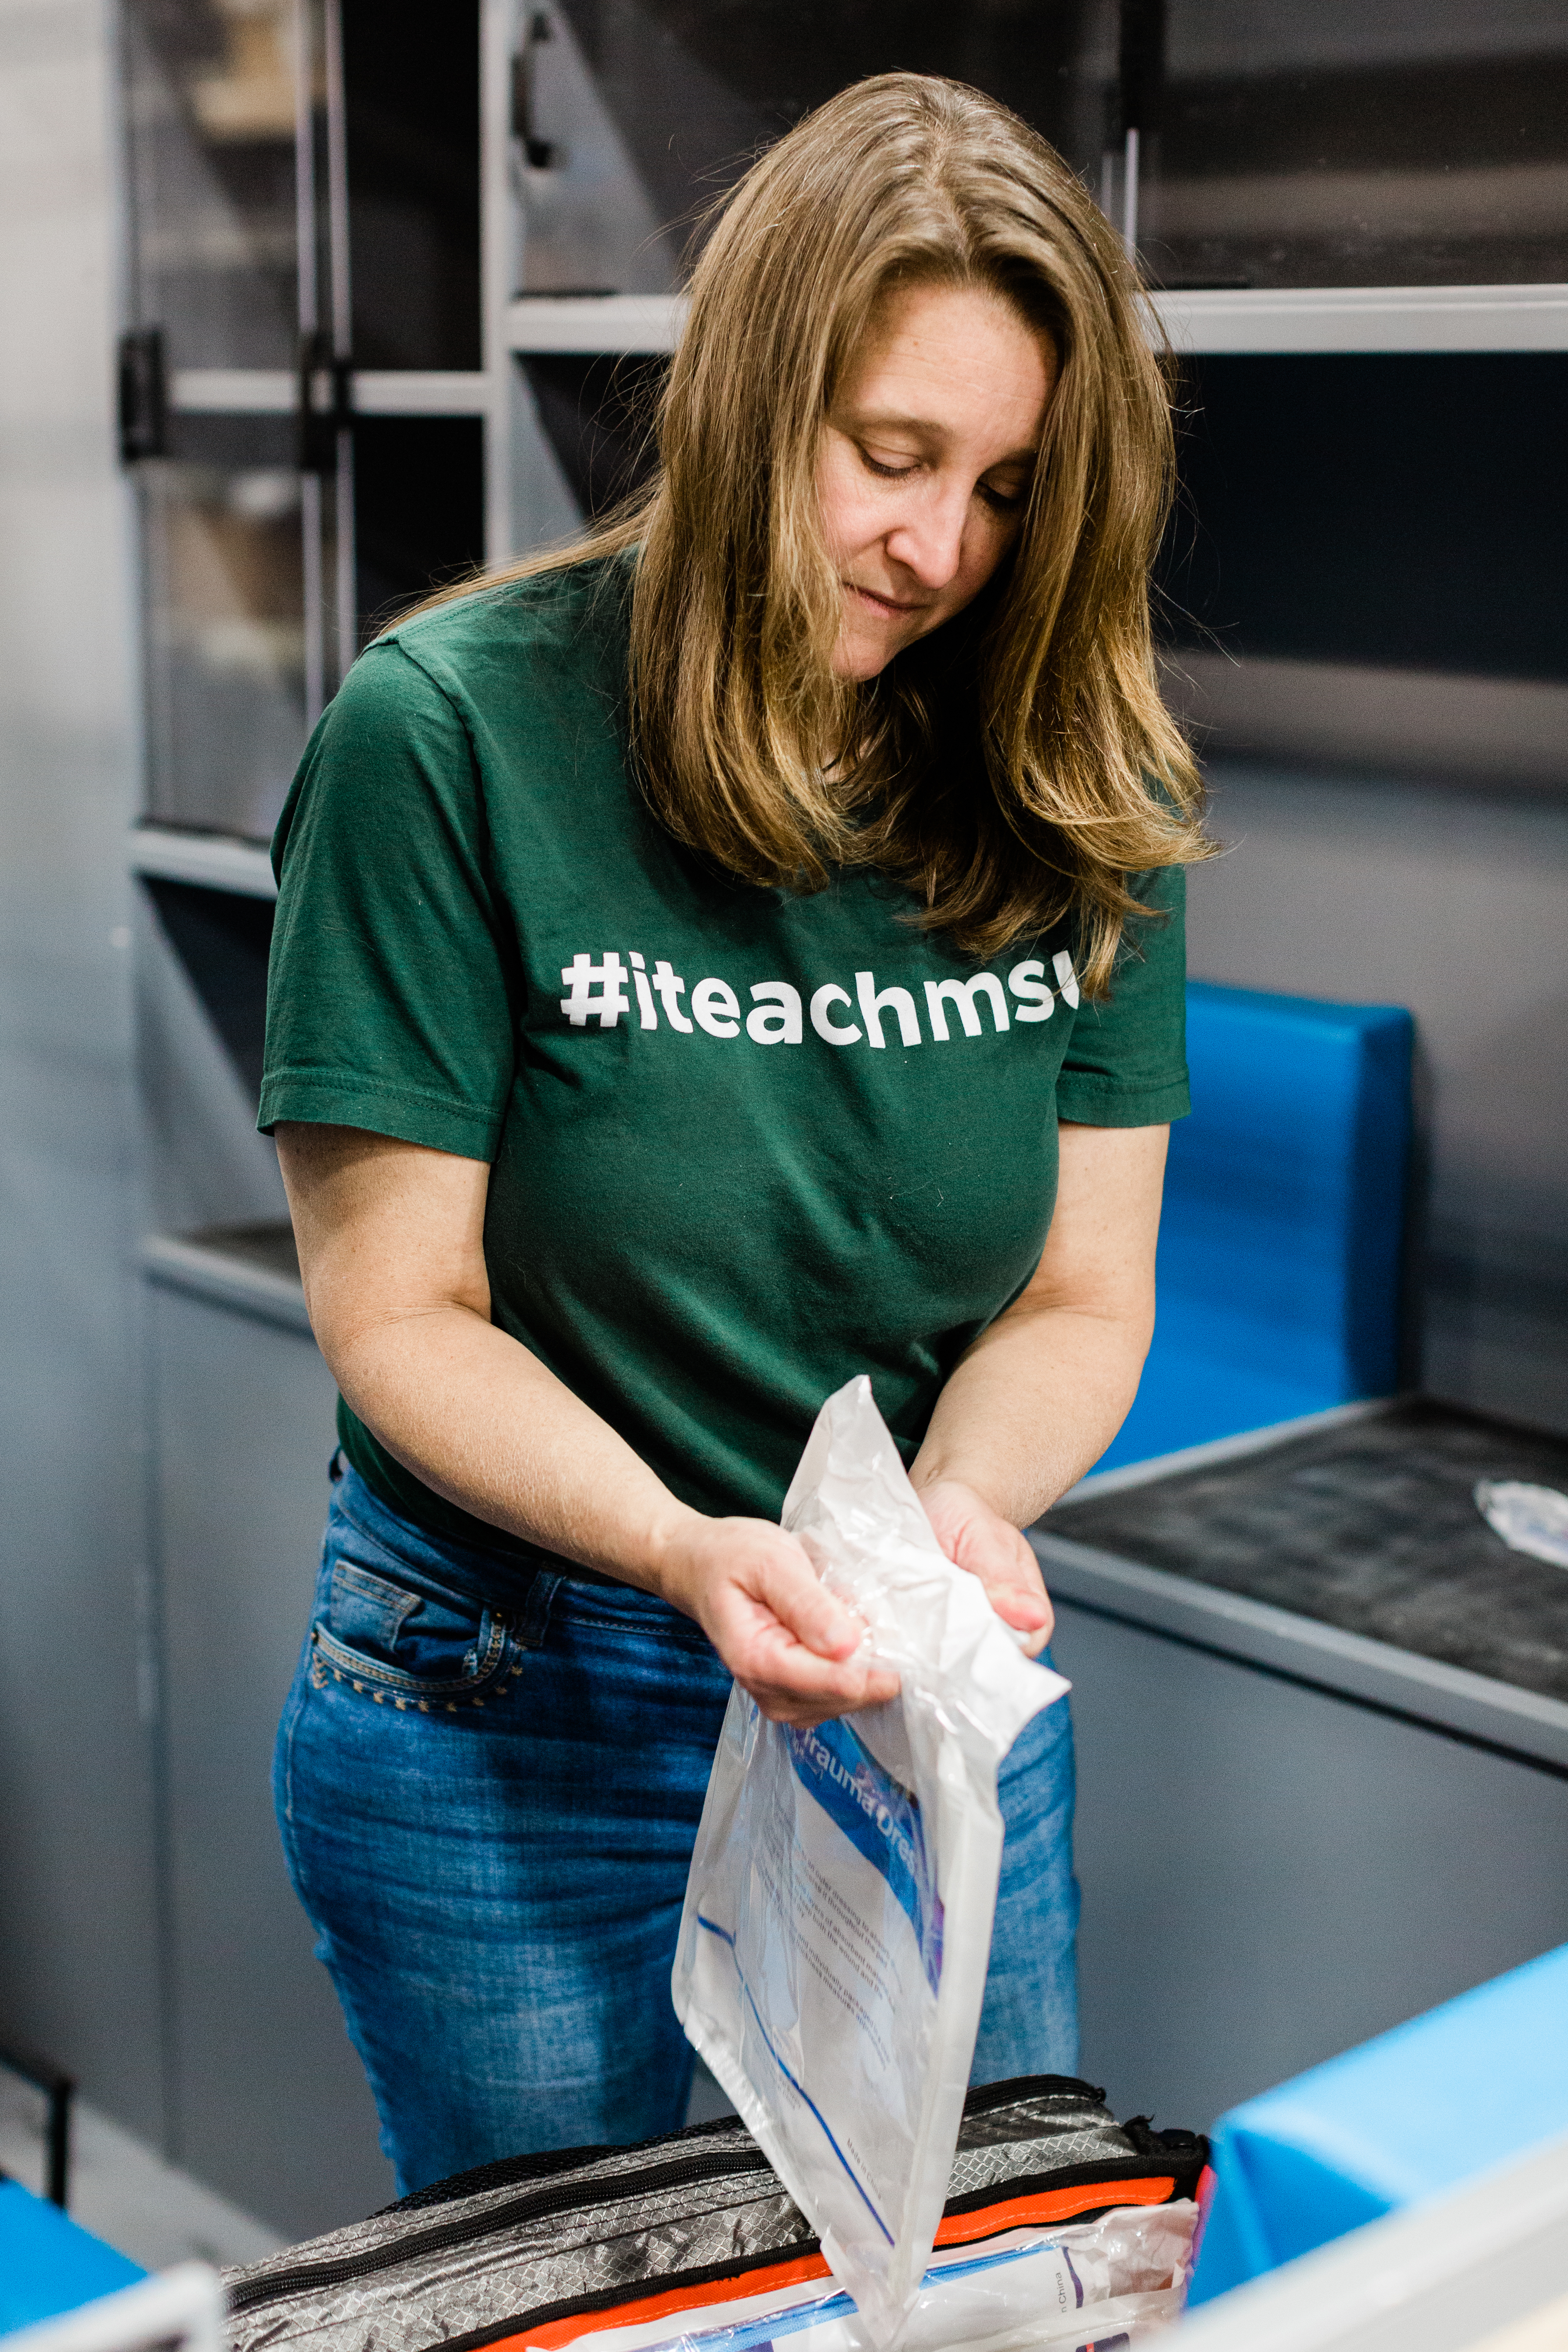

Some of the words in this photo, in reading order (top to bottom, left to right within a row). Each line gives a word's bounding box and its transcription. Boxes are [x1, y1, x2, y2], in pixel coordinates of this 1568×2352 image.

[828, 1897, 864, 1940] throughout
[865, 1936, 876, 1952] the
[833, 1890, 861, 1926] dressing
[861, 1921, 869, 1932] to
[813, 1913, 826, 1933] both
[827, 1930, 838, 1946] the
[839, 1944, 860, 1972] wound
[860, 1969, 873, 1988] and
[833, 1926, 865, 1965] absorbent
[809, 1946, 843, 1991] individually
[823, 1975, 854, 2016] measures
[847, 2138, 861, 2164] Made
[1056, 2272, 1067, 2304] China
